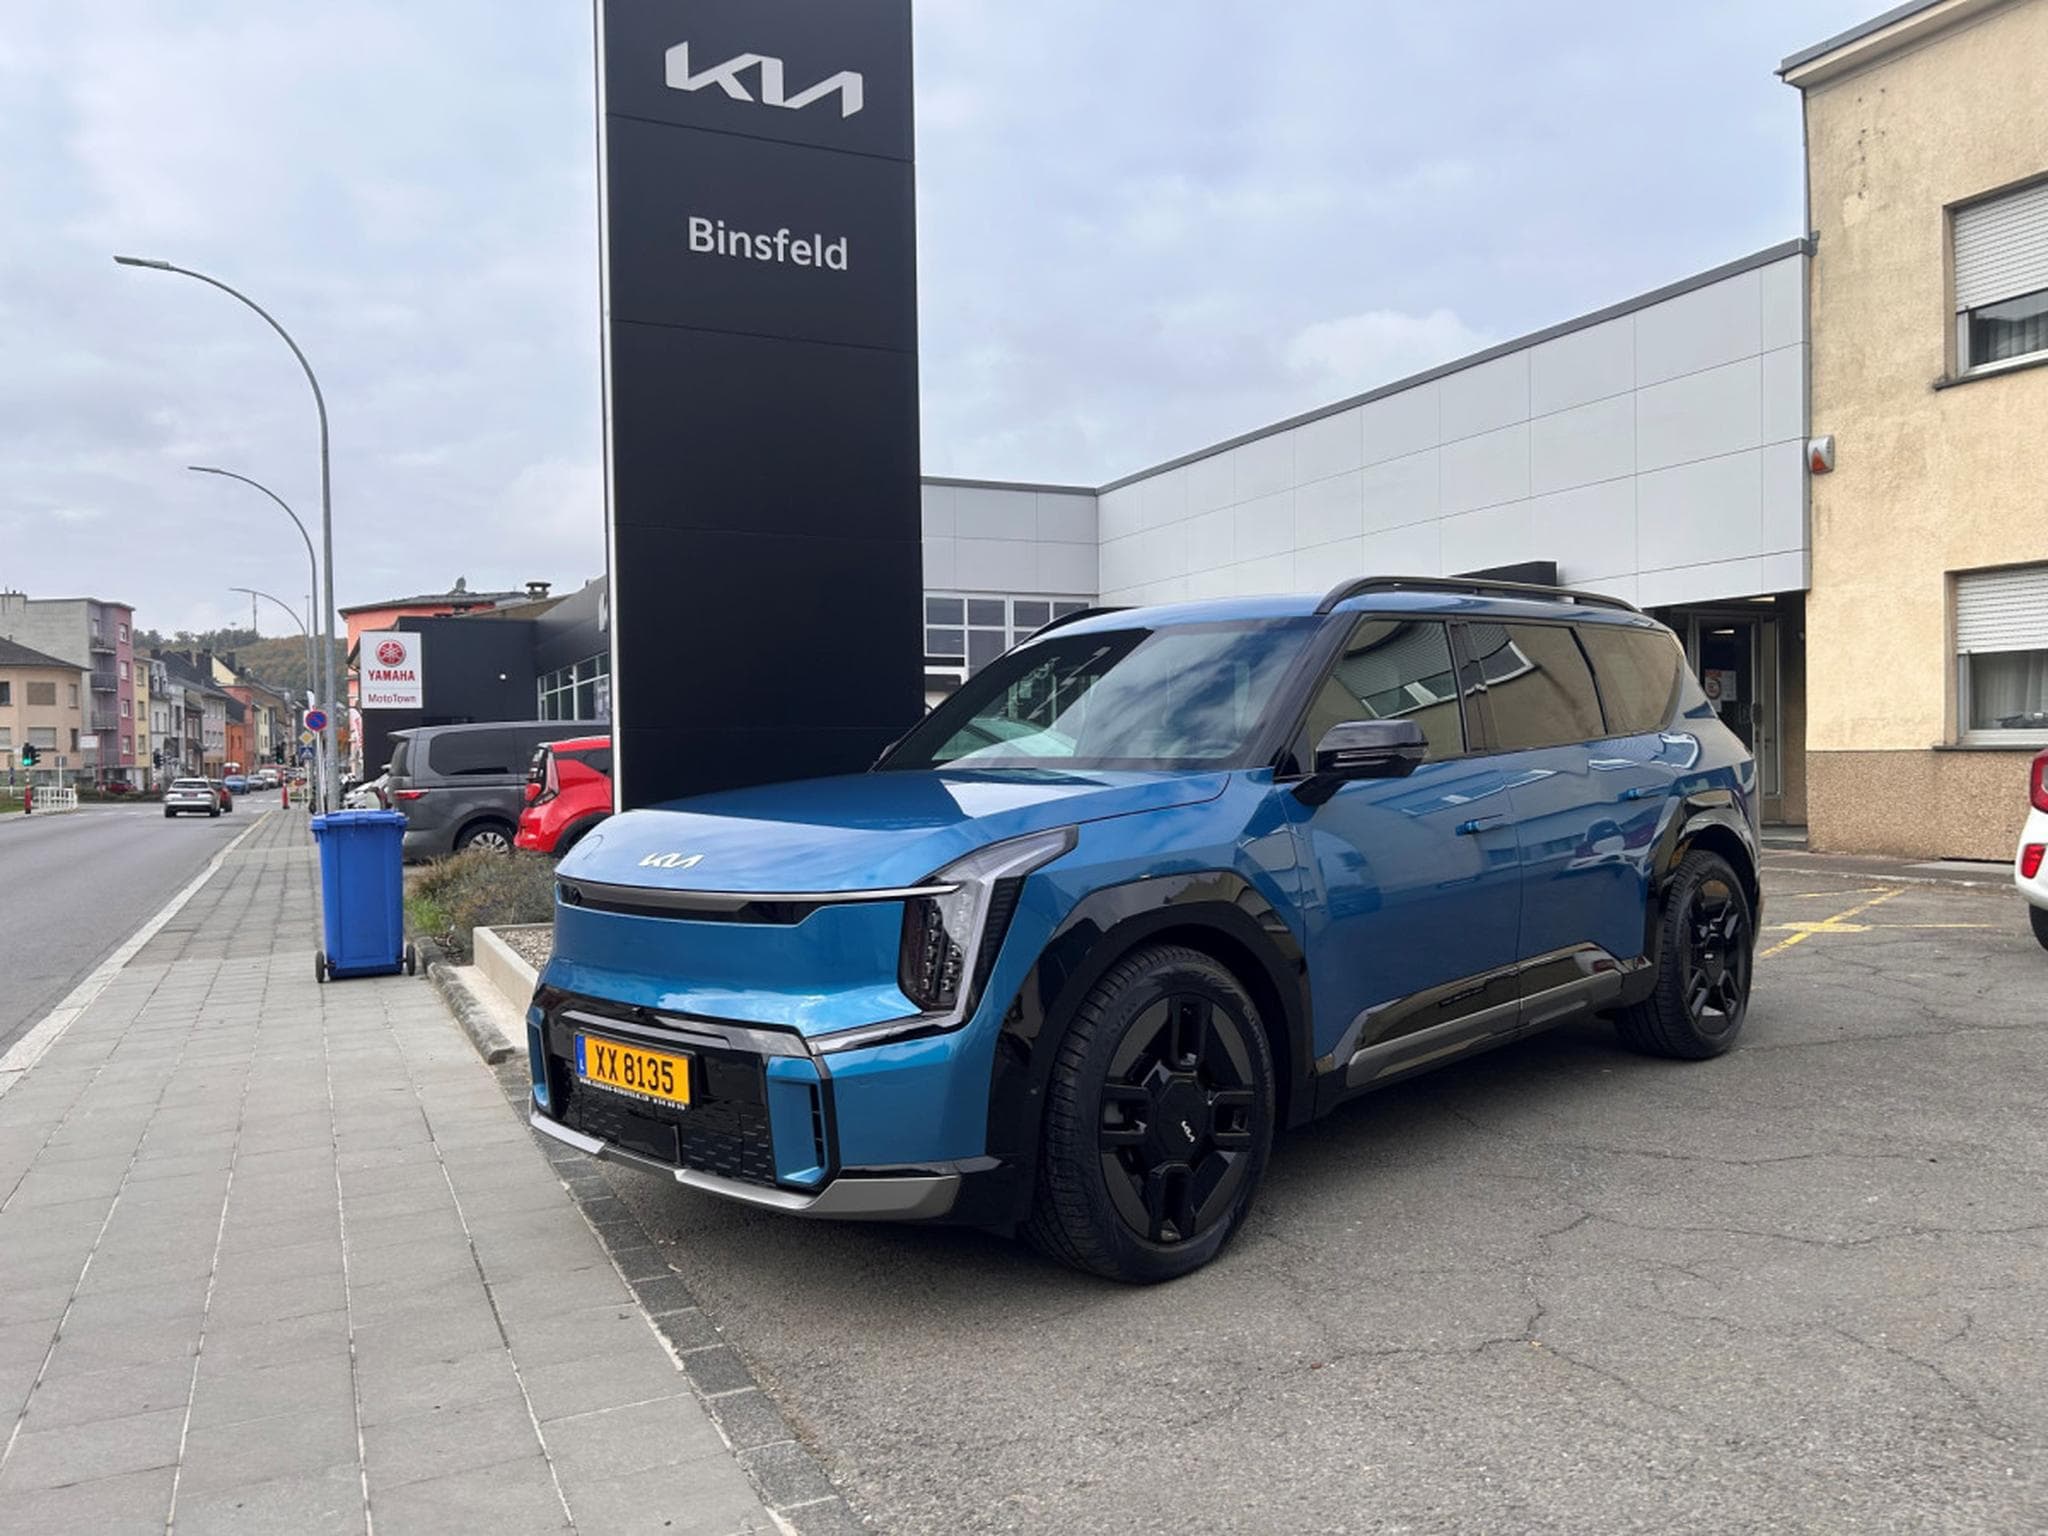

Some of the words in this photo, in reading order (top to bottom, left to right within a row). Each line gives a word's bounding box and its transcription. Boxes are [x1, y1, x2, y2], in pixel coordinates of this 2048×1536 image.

[665, 41, 863, 118] KIA
[689, 217, 848, 271] Binsfeld
[368, 669, 416, 682] YAMAHA
[368, 694, 417, 704] MotoTown
[638, 852, 704, 869] KIA
[595, 1045, 618, 1081] XX
[623, 1053, 674, 1094] 8135
